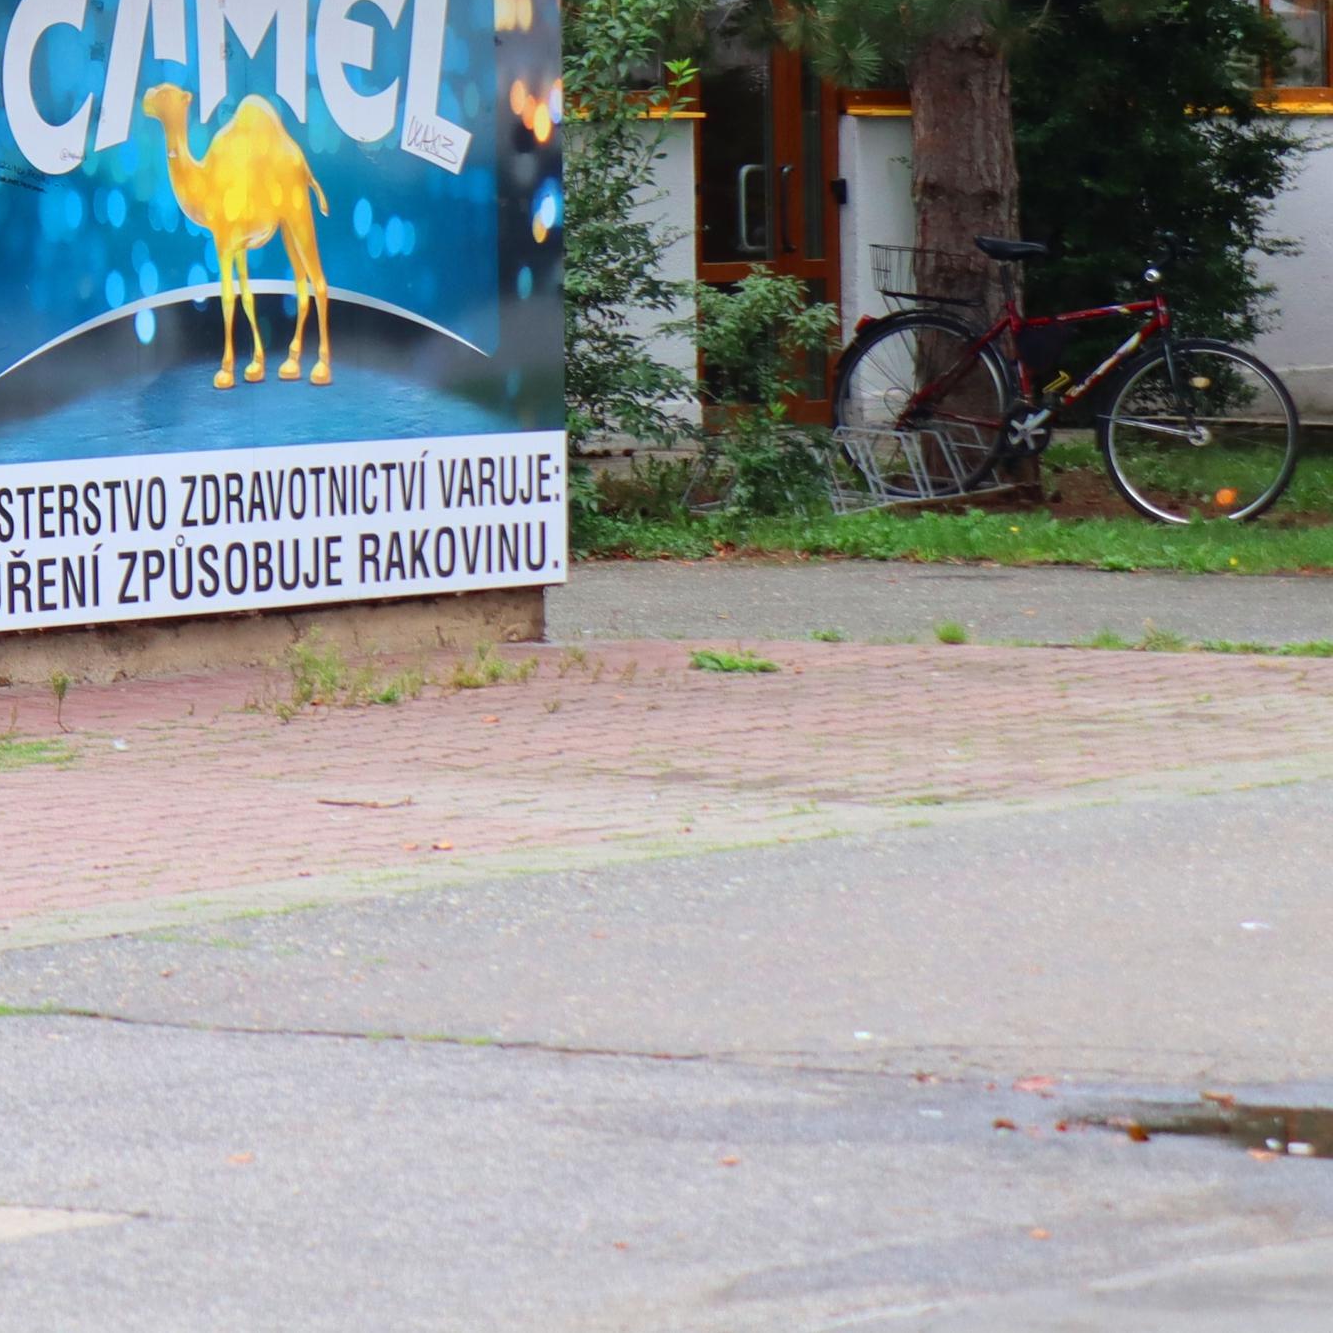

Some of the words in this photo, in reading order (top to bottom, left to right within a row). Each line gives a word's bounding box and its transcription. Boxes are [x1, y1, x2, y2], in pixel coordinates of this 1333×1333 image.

[180, 452, 427, 527] ZDRAVOTNICTVÍ
[439, 453, 561, 509] VARUJE:
[118, 534, 342, 604] ZPŮSOBUJE
[359, 521, 559, 583] RAKOVINU.
